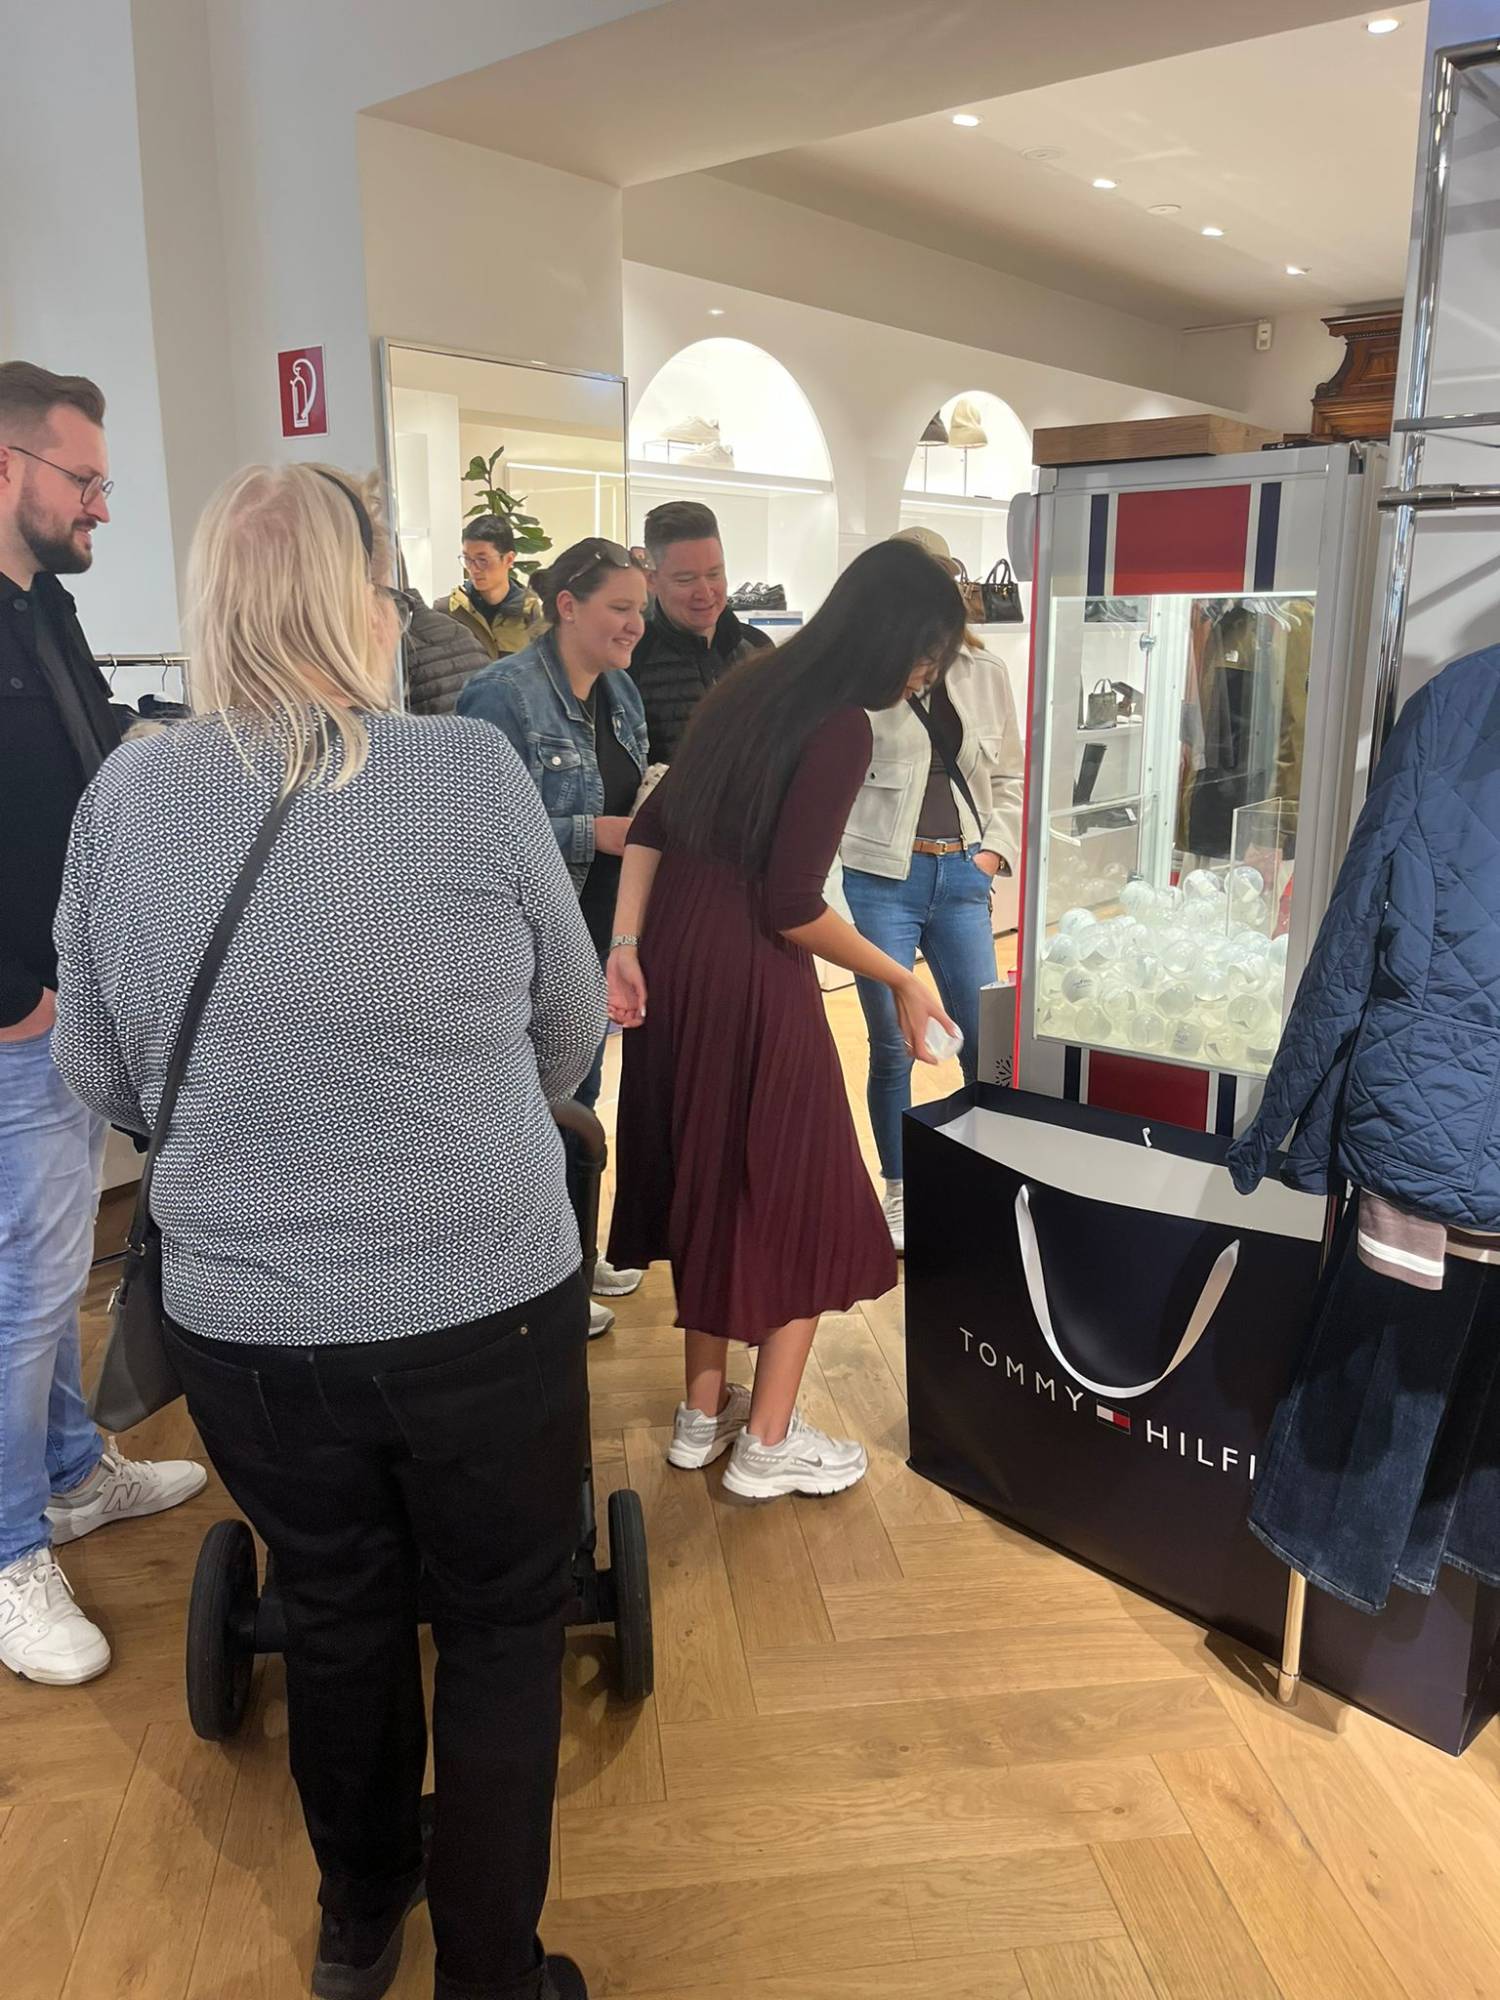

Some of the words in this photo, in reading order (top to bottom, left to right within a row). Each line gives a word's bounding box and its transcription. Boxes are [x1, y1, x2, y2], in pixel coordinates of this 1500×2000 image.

[959, 1327, 1084, 1411] TOMMY
[1146, 1419, 1256, 1480] HILFI
[102, 1482, 142, 1514] N
